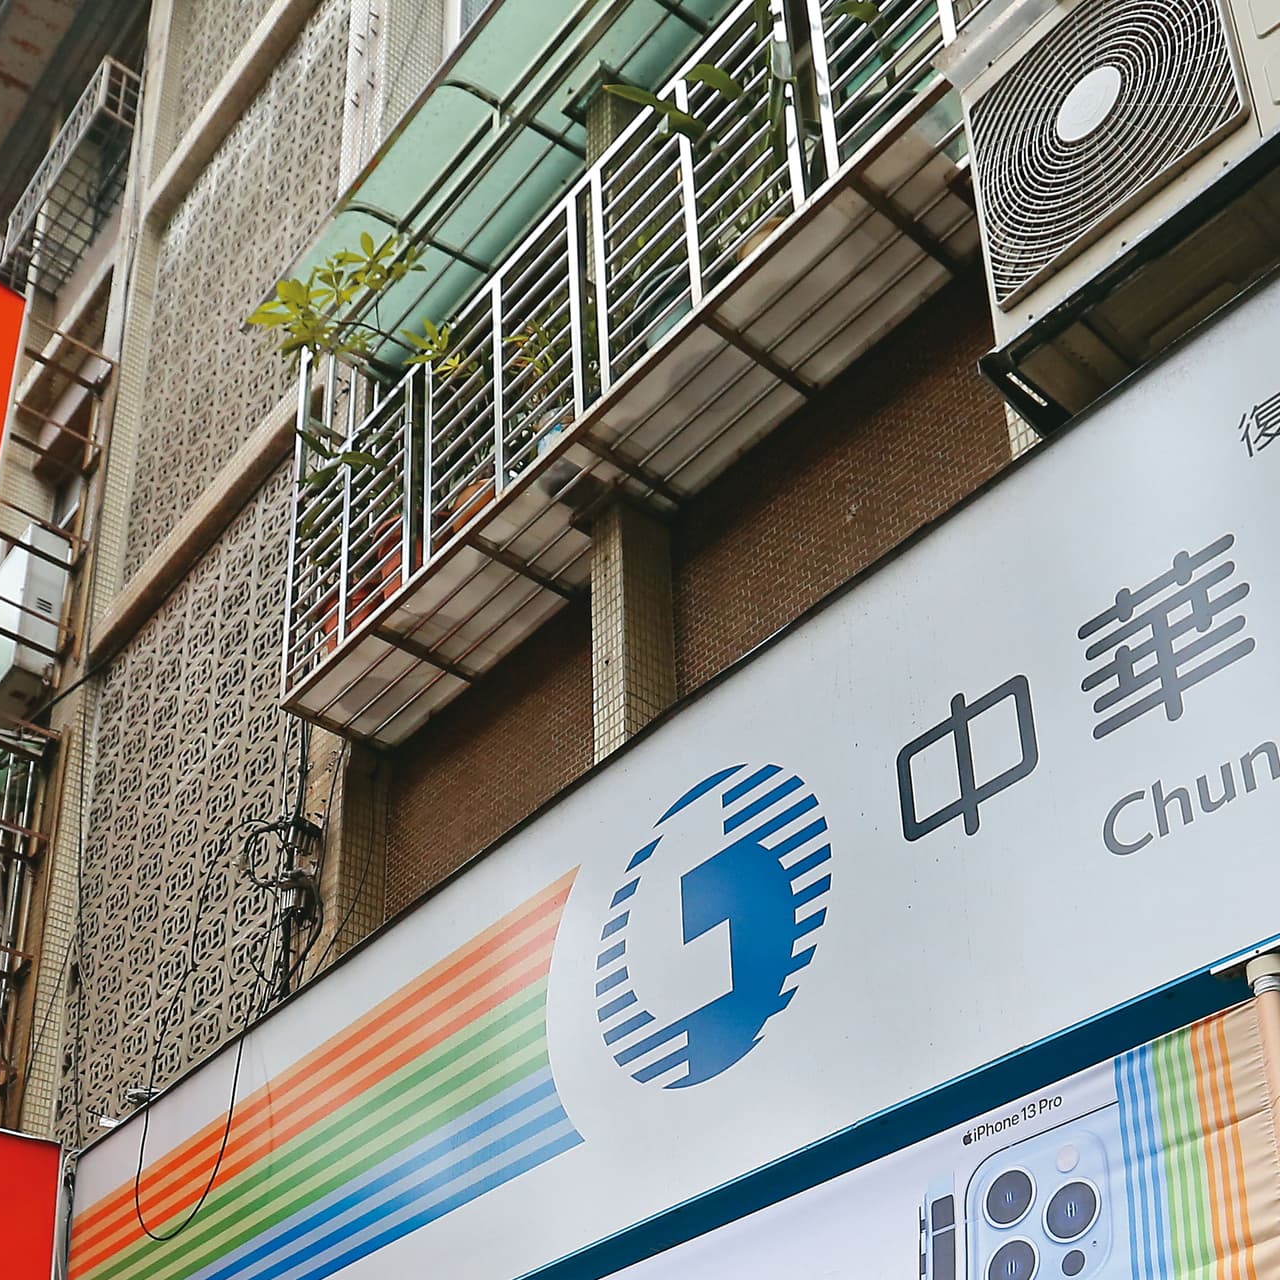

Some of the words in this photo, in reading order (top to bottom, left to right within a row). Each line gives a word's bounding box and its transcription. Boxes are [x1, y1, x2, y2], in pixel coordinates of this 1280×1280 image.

[973, 1113, 1020, 1143] iPhone
[1020, 1102, 1038, 1121] 13
[1039, 1094, 1063, 1116] Pro
